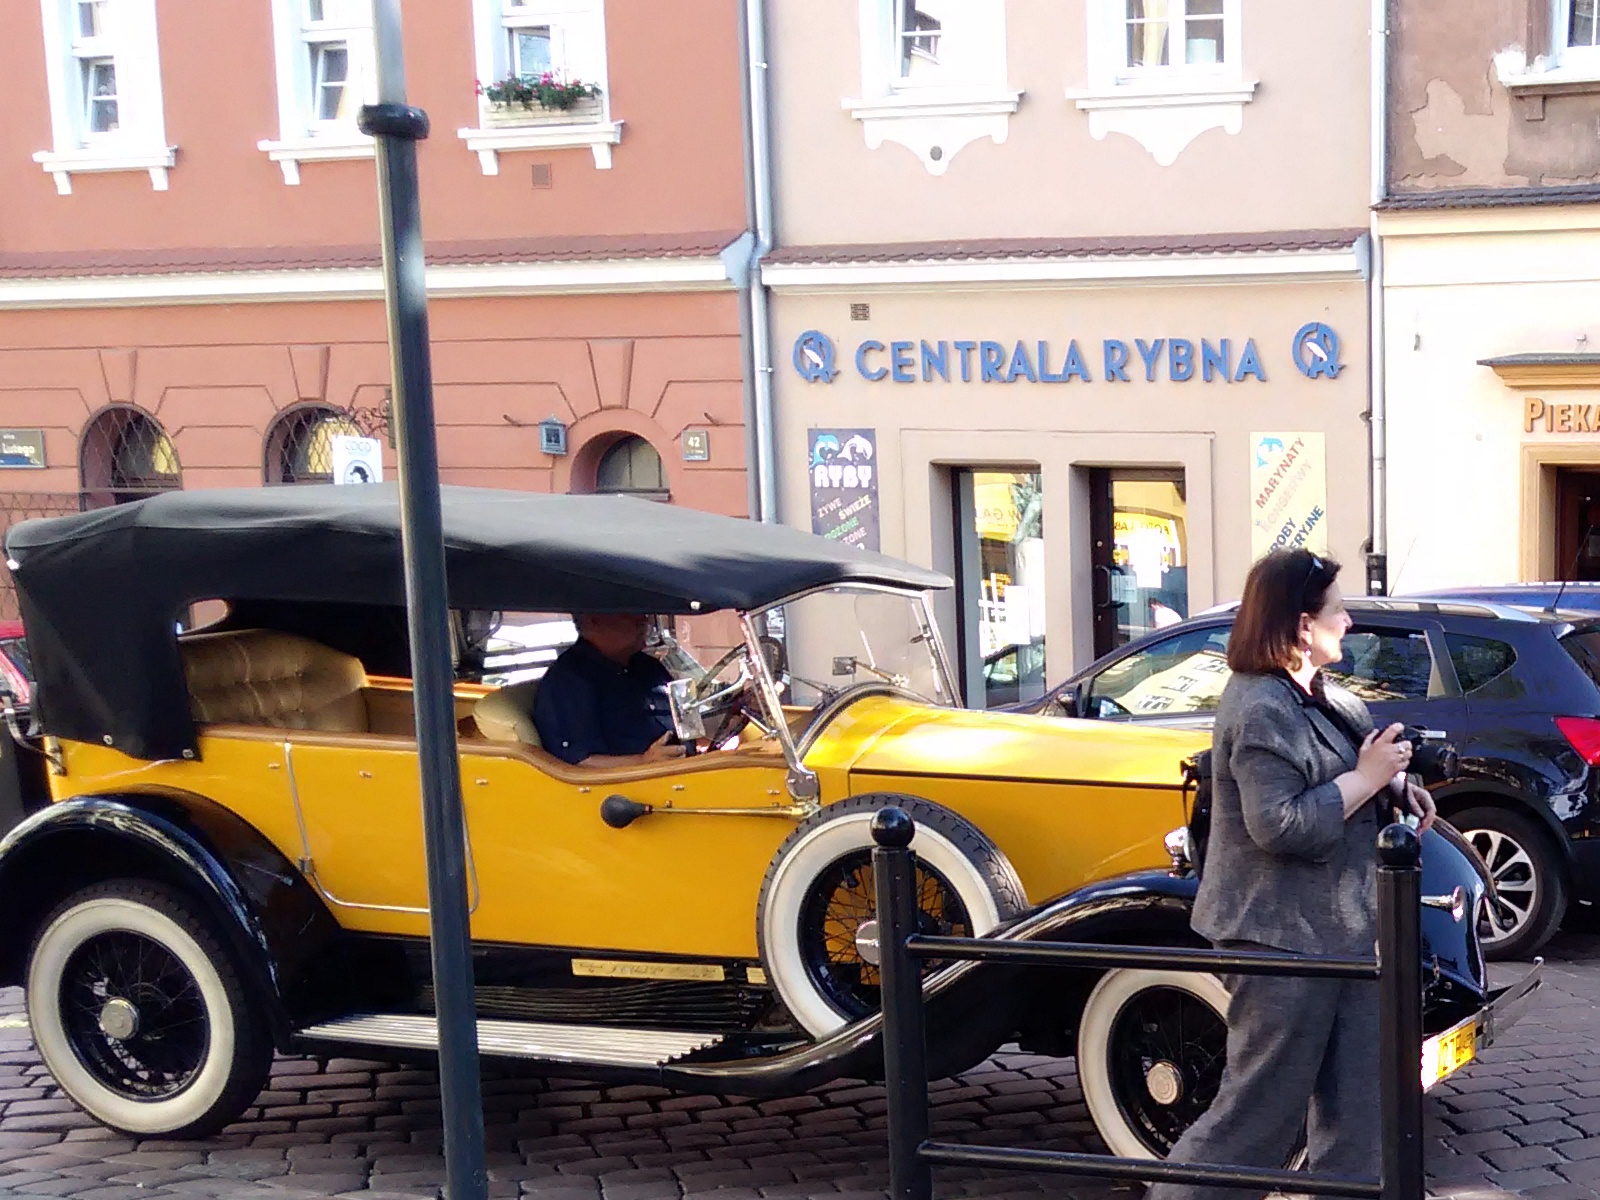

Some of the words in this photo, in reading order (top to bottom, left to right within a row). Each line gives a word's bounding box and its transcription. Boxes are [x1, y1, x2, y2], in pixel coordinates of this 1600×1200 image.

[855, 339, 1093, 383] CENTRALA
[1104, 337, 1267, 383] RYBNA
[686, 437, 700, 449] 42
[814, 464, 872, 488] RYBY
[1255, 437, 1305, 509] MARYNATY
[1267, 517, 1297, 555] ROBY
[1289, 505, 1325, 553] ERYJNE
